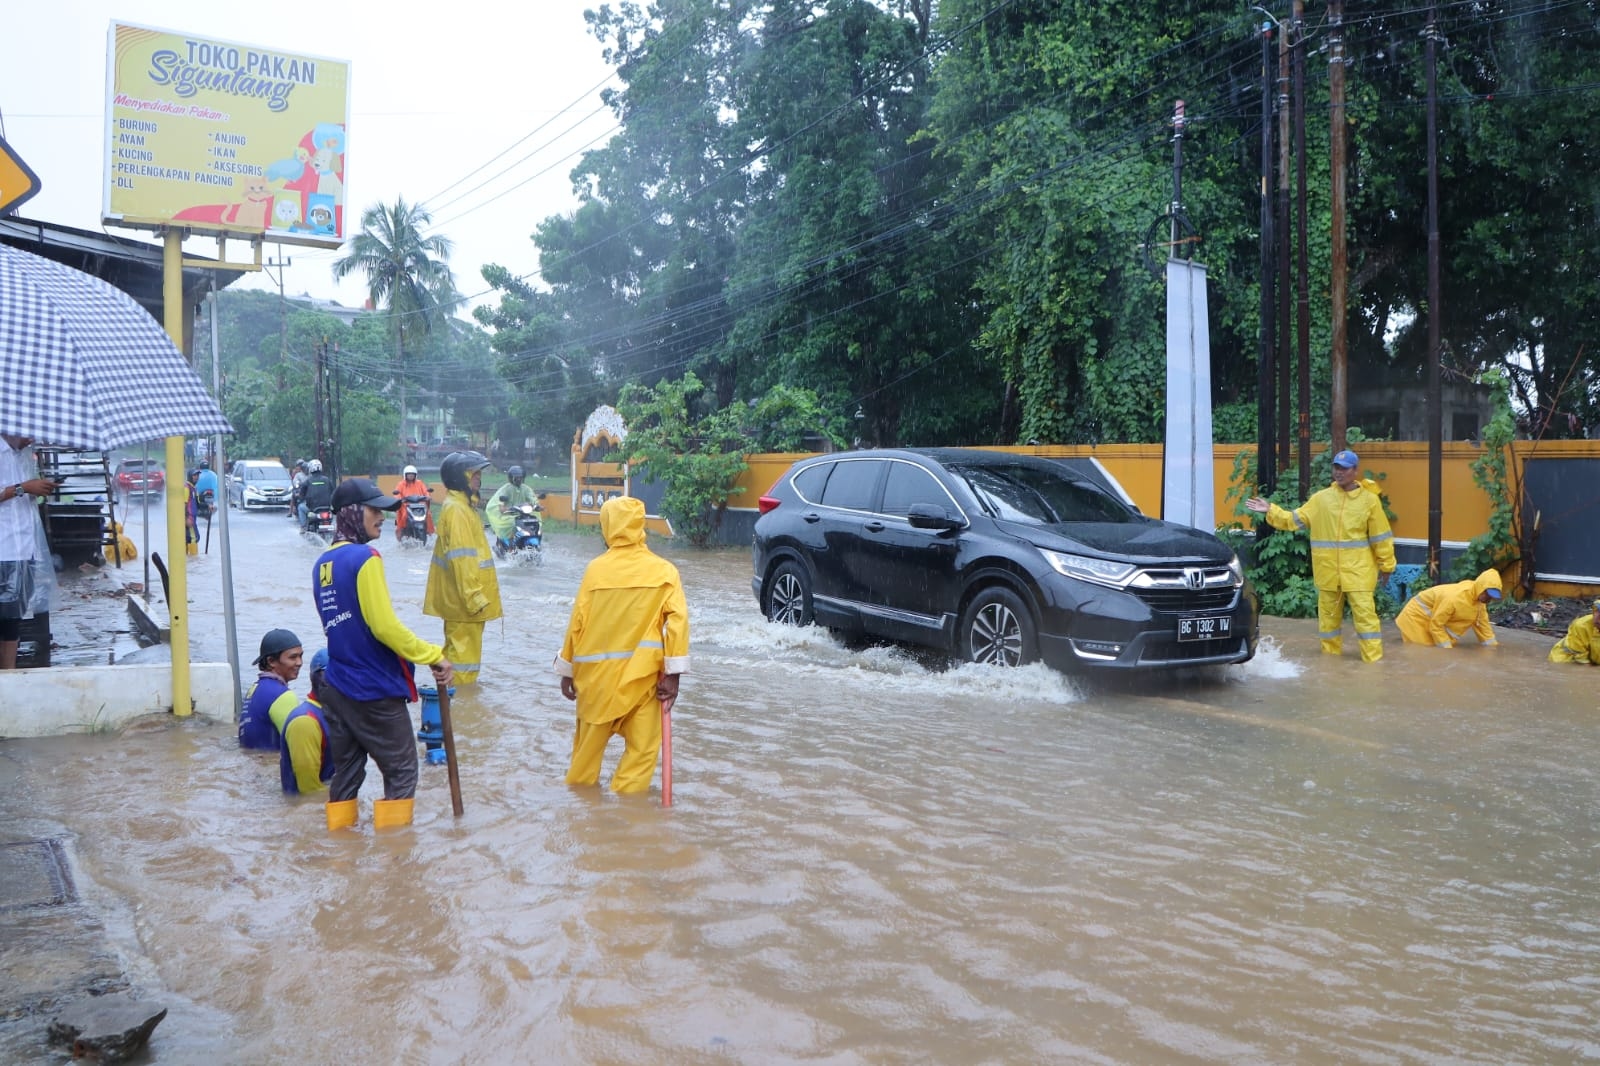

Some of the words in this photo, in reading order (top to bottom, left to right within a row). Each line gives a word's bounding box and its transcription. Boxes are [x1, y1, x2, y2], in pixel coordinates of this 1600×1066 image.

[186, 40, 239, 71] TOKO
[247, 51, 315, 84] PAKAN
[148, 50, 294, 111] Siguntang
[113, 95, 186, 114] Menyediakan
[119, 118, 158, 133] BURUNG
[119, 133, 145, 146] AYAM
[215, 132, 247, 146] ANJING
[118, 147, 153, 162] KUCING
[214, 146, 236, 159] IKAN
[118, 162, 190, 181] PERLENGKAPAN
[195, 172, 233, 187] PANCING
[214, 160, 263, 177] AKSESORIS
[117, 176, 134, 189] DLL
[1181, 621, 1191, 633] BG
[1196, 620, 1214, 632] 1302
